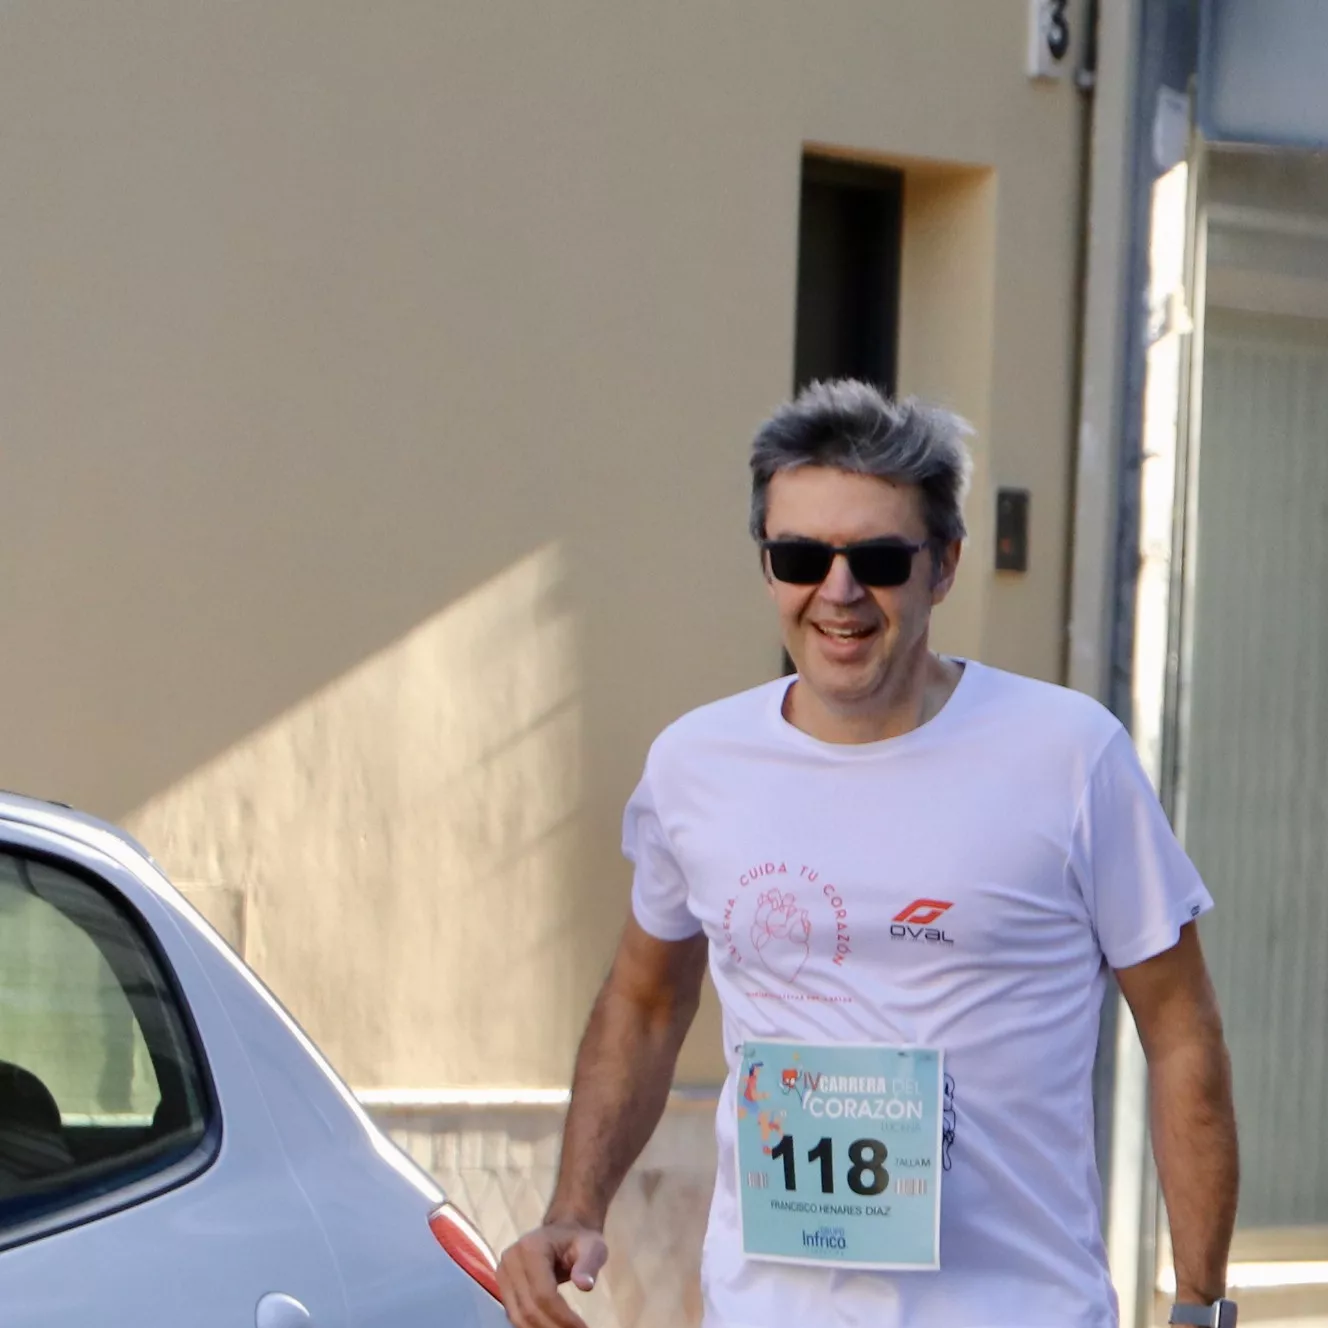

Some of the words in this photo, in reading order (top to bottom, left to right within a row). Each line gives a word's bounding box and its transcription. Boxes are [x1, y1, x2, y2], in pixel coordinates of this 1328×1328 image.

[740, 862, 788, 887] CUIDA
[799, 865, 820, 882] TU
[804, 1072, 821, 1091] IV
[820, 1075, 887, 1095] CARRERA
[892, 1078, 921, 1095] DEL
[772, 1134, 889, 1196] 118
[770, 1200, 817, 1214] FRANCISCO
[819, 1204, 862, 1216] HENARES
[802, 1229, 847, 1250] Infrico
